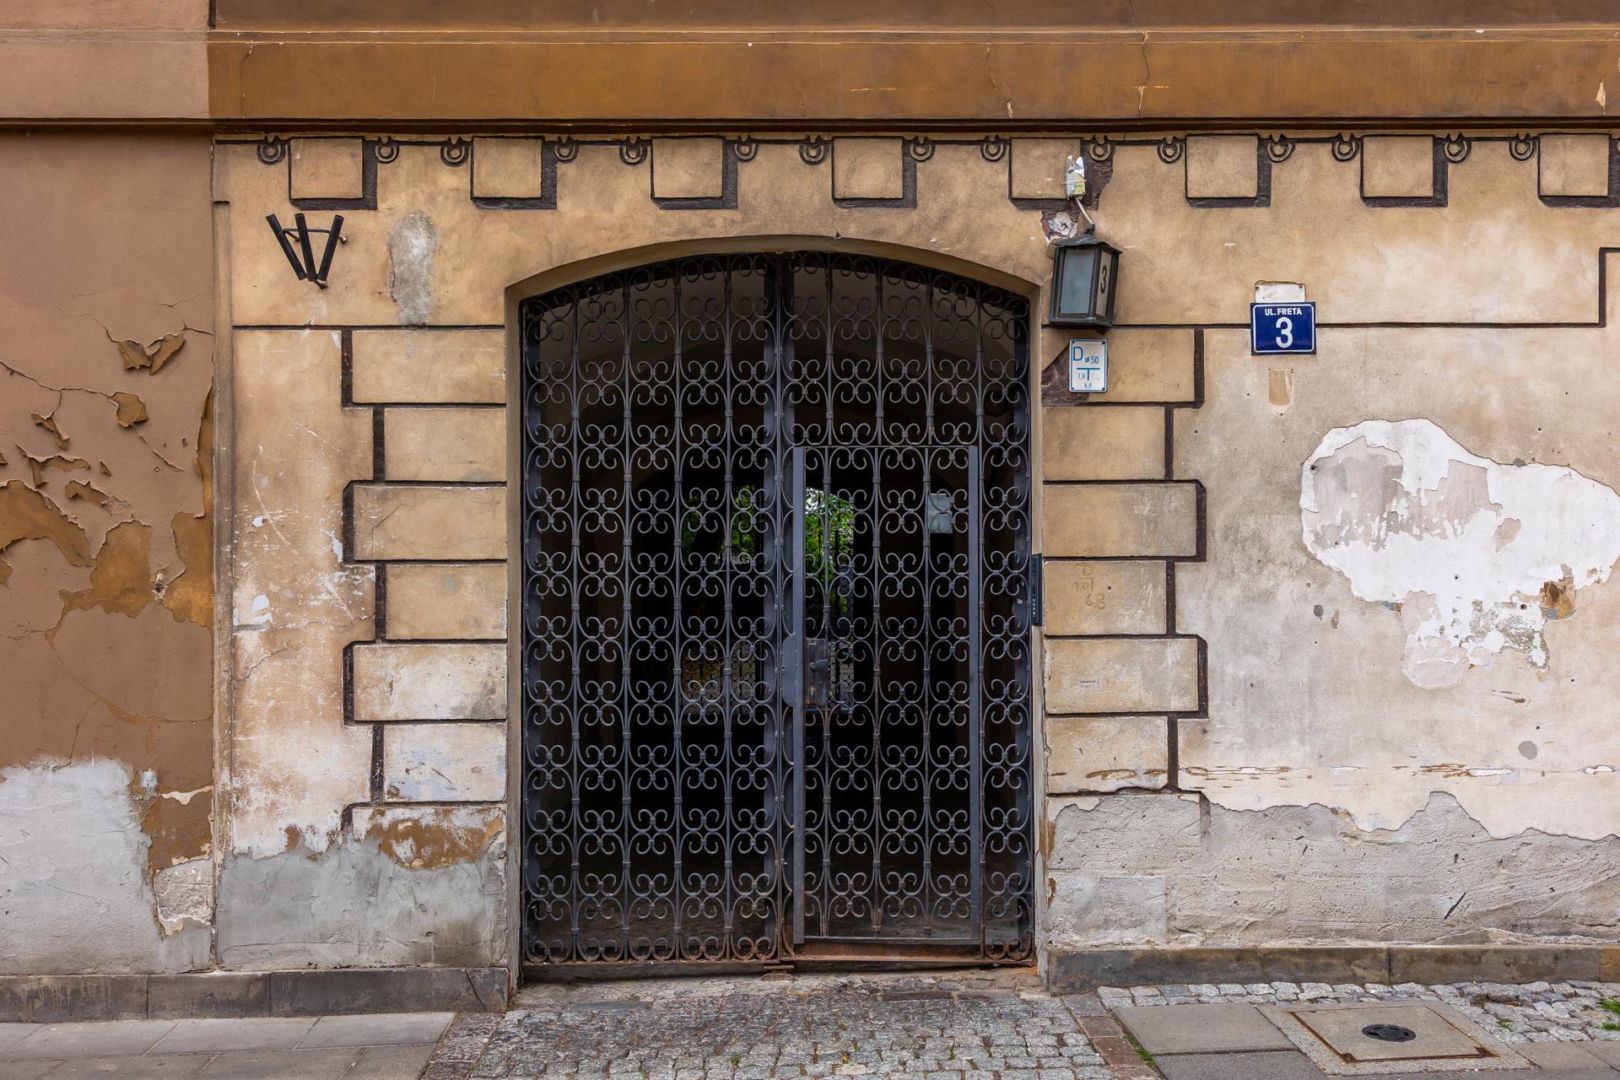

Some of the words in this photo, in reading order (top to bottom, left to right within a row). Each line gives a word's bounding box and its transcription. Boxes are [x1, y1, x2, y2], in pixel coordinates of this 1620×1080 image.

[1100, 264, 1108, 294] 3
[1275, 316, 1293, 349] 3
[1073, 346, 1084, 361] D
